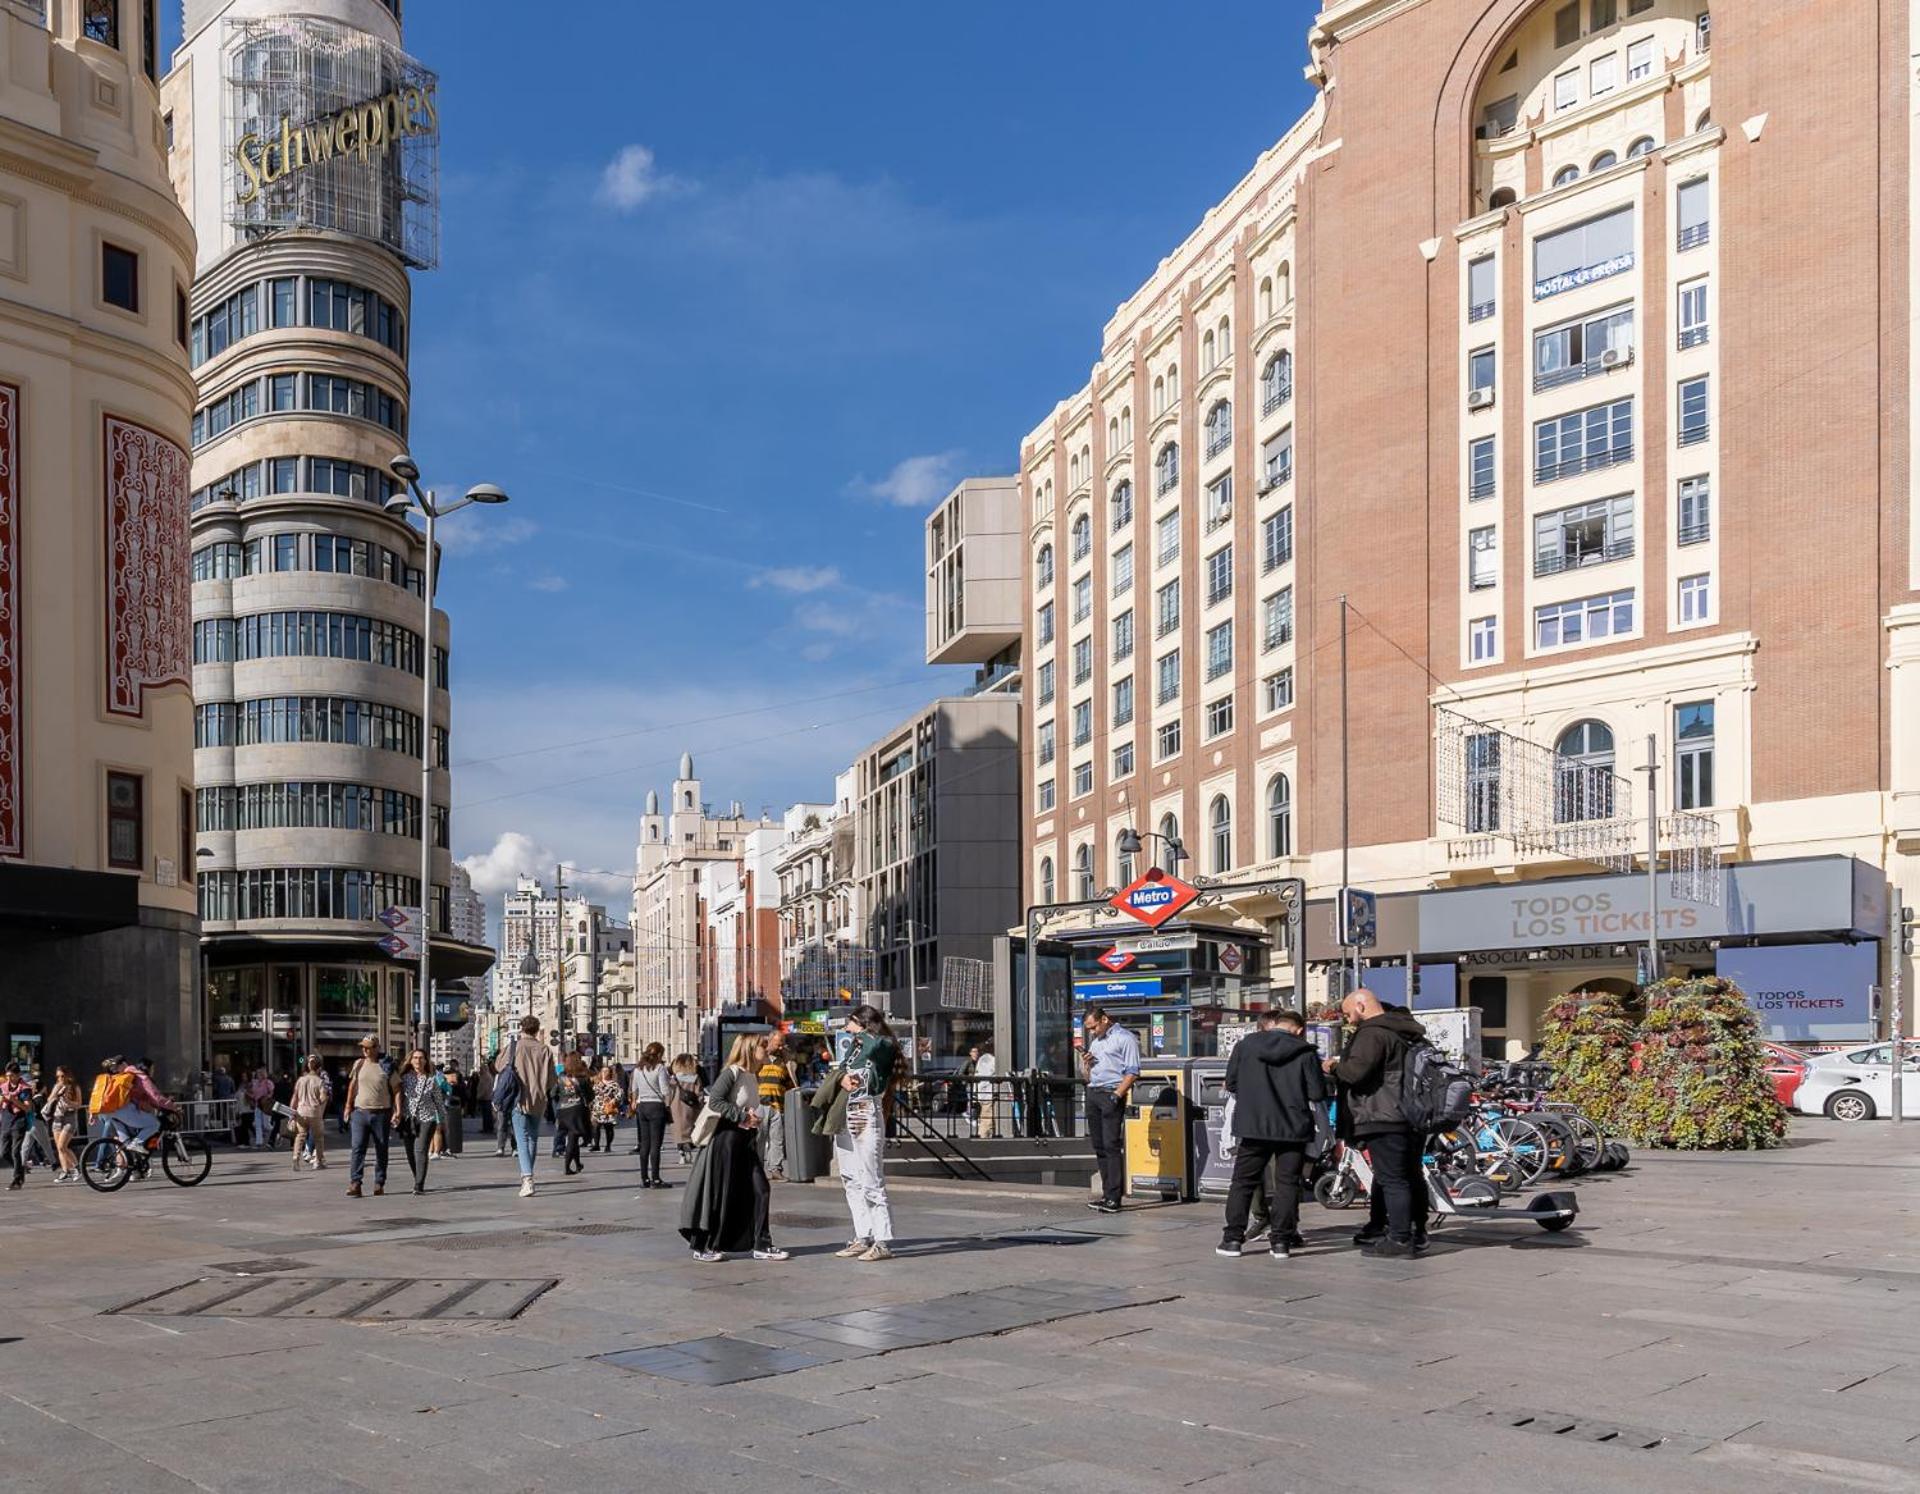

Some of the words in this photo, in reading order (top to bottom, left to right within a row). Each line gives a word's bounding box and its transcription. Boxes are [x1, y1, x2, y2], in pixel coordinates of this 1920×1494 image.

[236, 83, 436, 204] Schweppes
[1535, 275, 1575, 295] HOSTAL
[1133, 890, 1170, 905] Metro
[1512, 894, 1610, 917] TODOS
[1512, 917, 1566, 939] LOS
[1576, 908, 1697, 934] TICKETS
[1581, 946, 1603, 959] DE
[1638, 940, 1712, 957] ENSA
[1757, 991, 1805, 1000] TODOS
[1757, 1001, 1783, 1009] LOS
[1787, 999, 1844, 1008] TICKETS
